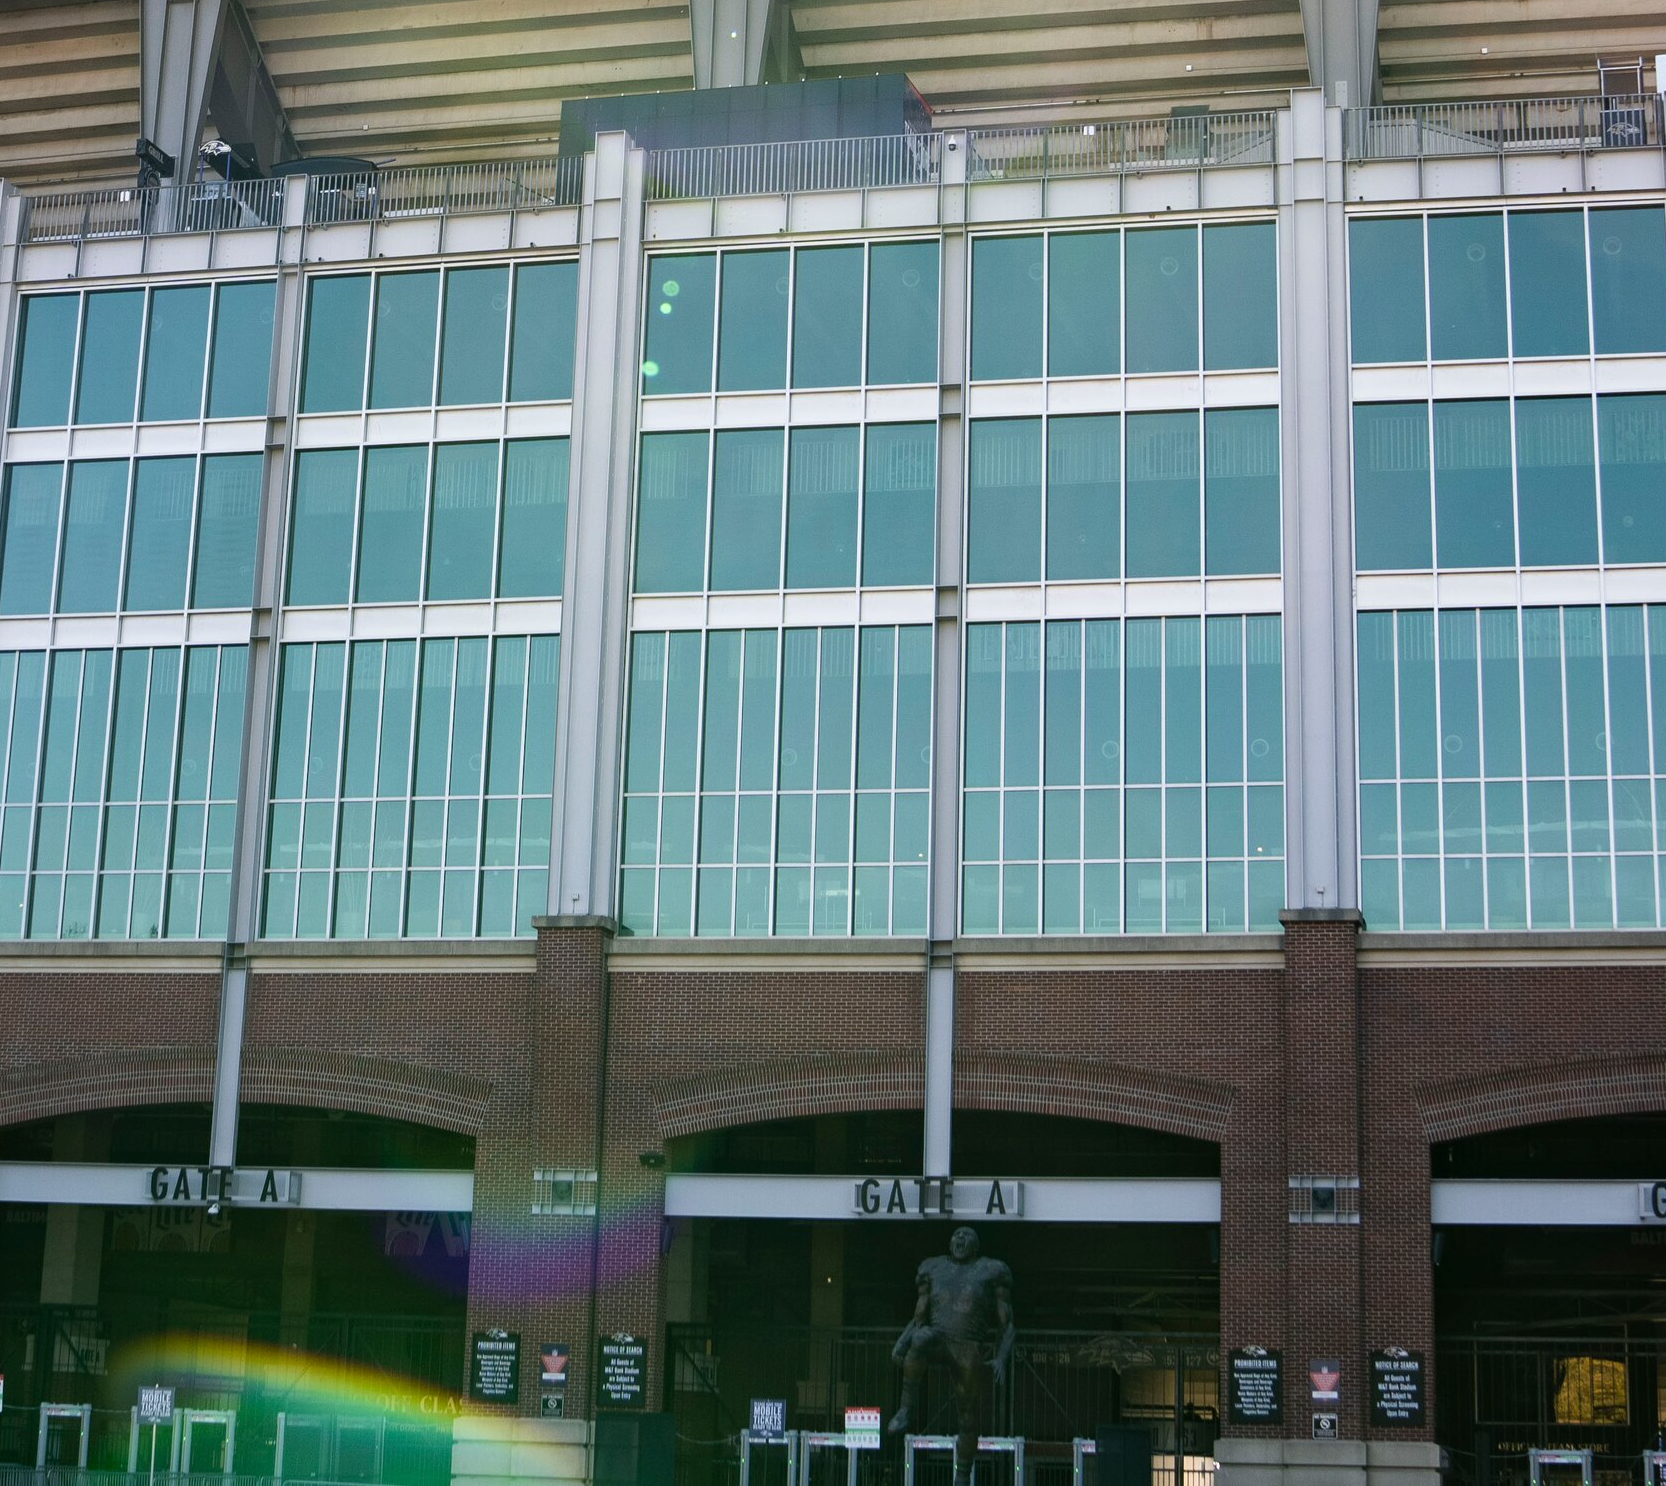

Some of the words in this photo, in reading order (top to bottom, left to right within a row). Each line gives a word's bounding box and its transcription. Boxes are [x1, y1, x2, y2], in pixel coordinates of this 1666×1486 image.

[150, 1166, 233, 1202] GATE
[259, 1169, 278, 1202] A
[861, 1178, 954, 1214] GATE
[986, 1179, 1006, 1215] A
[142, 1393, 171, 1403] MOBILE
[141, 1402, 171, 1412] TICKETS
[754, 1405, 782, 1416] MOBILE
[753, 1415, 782, 1425] TICKETS
